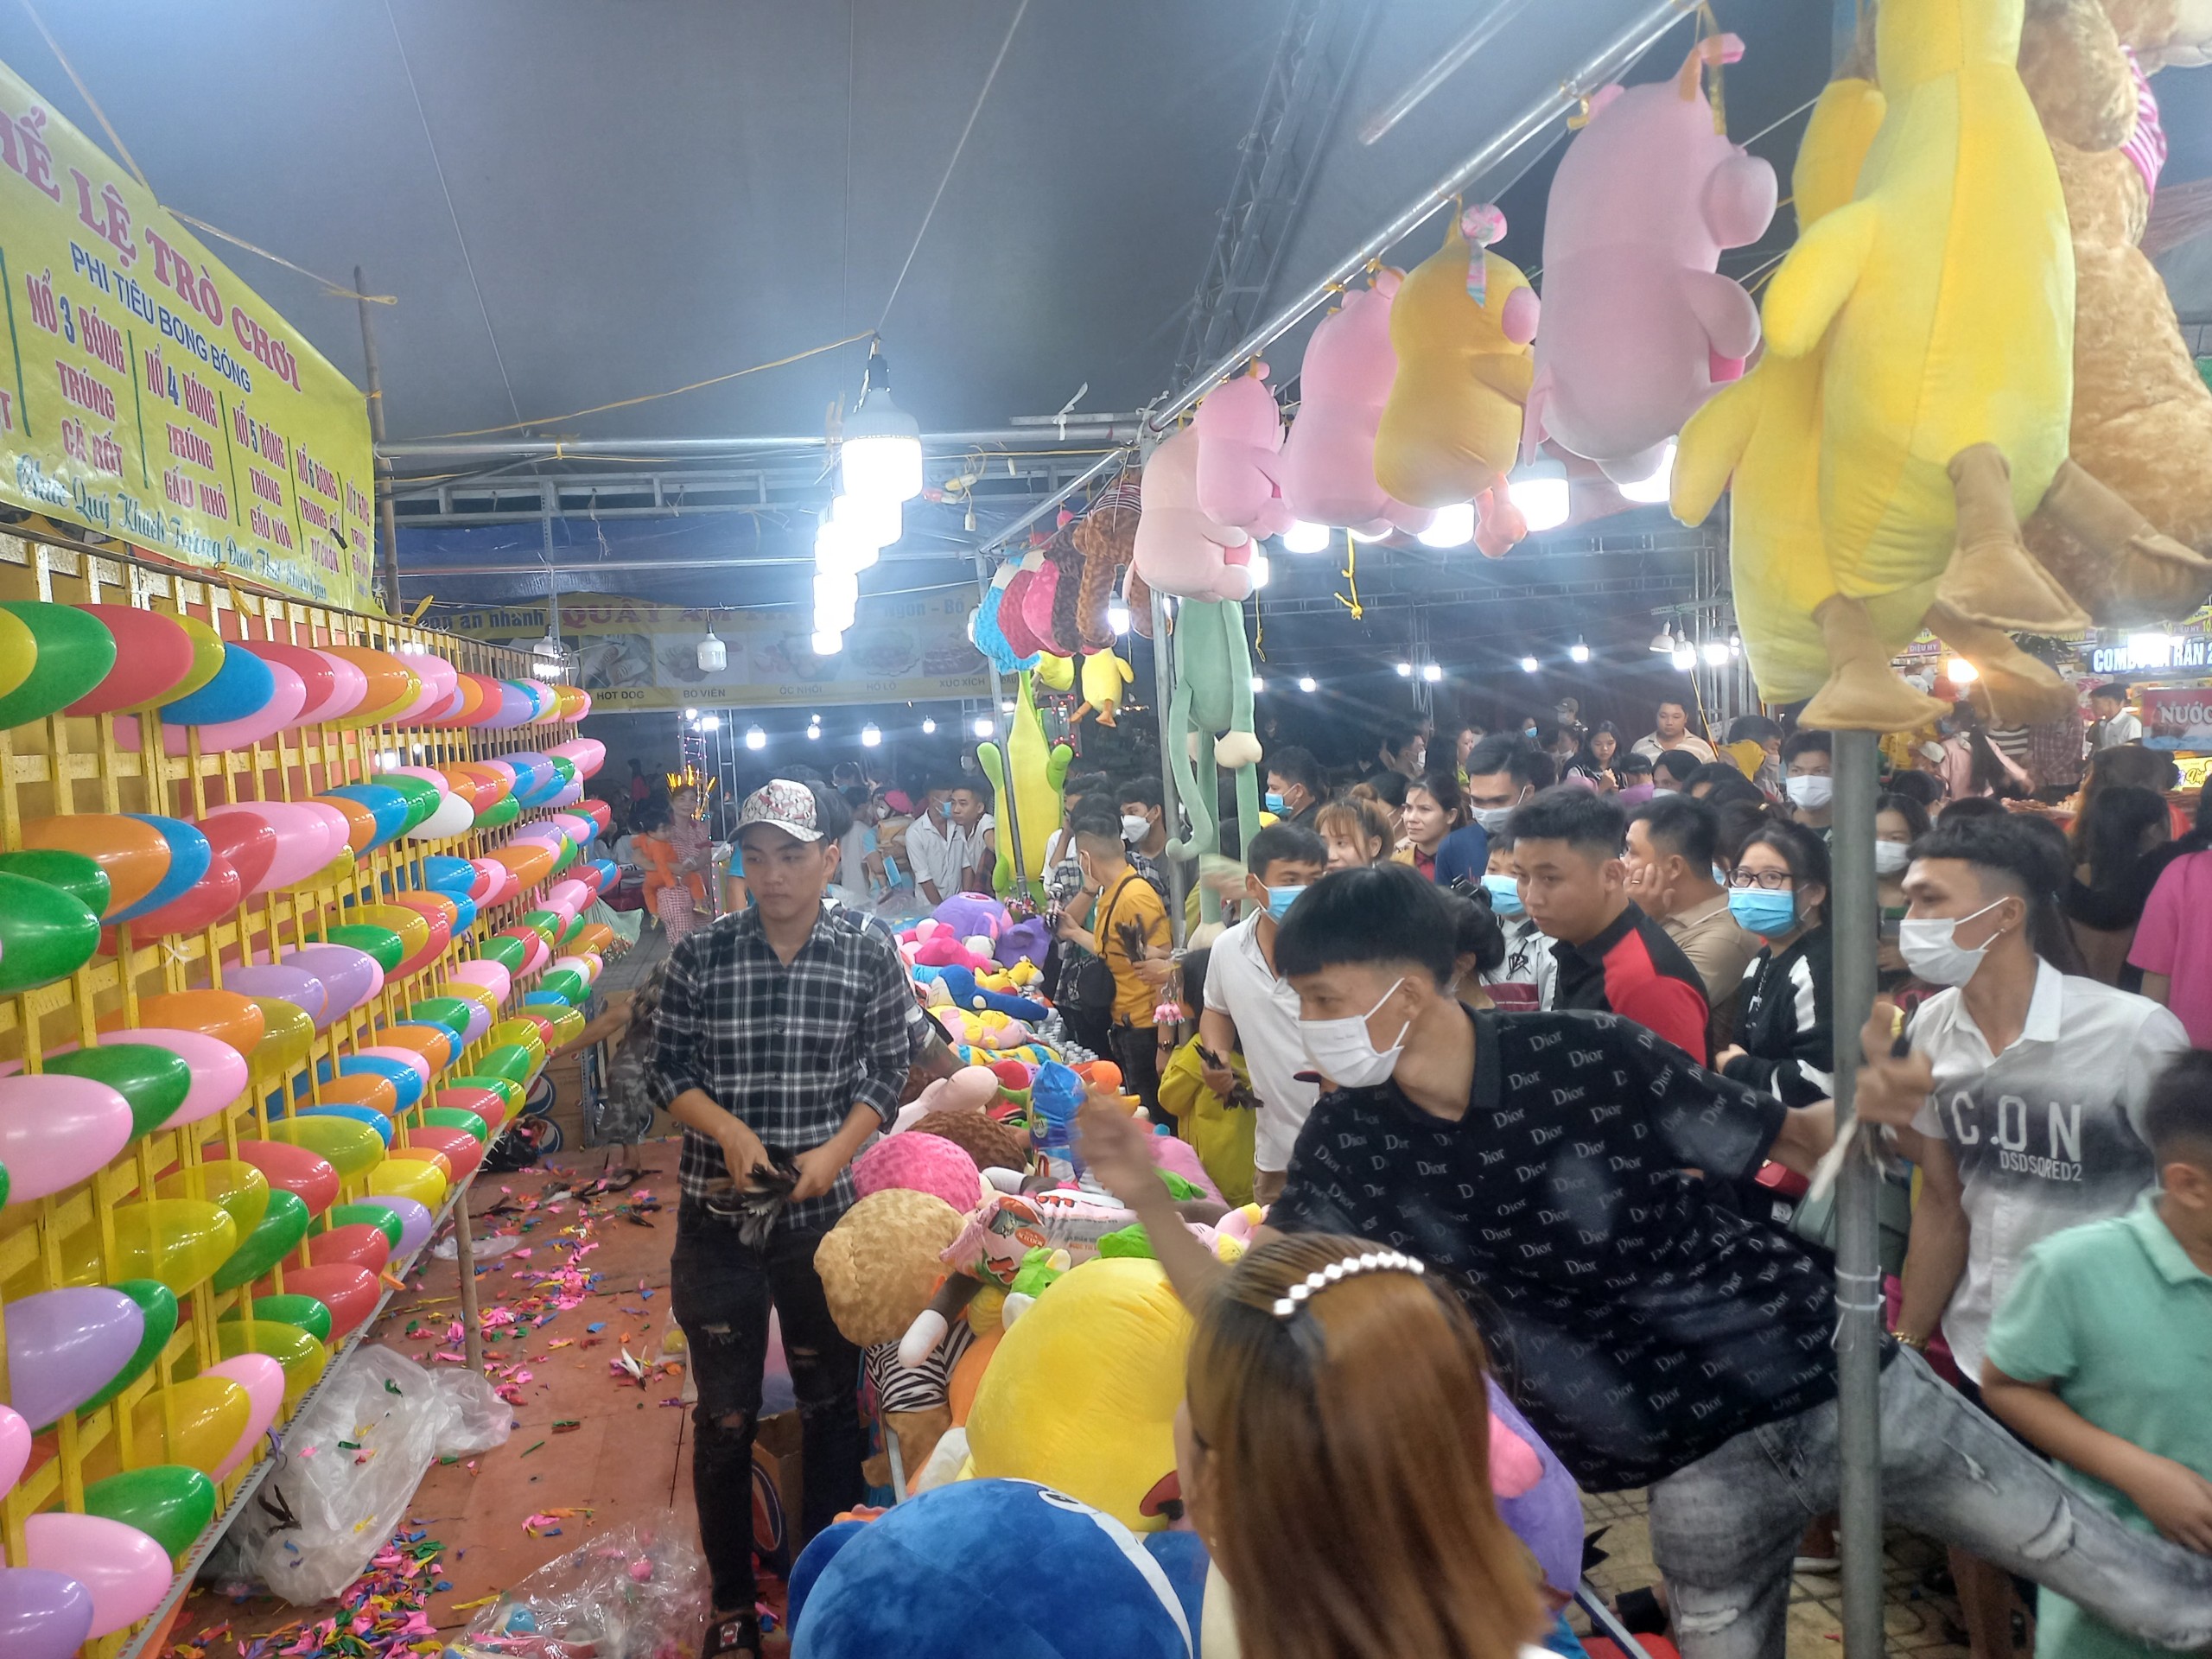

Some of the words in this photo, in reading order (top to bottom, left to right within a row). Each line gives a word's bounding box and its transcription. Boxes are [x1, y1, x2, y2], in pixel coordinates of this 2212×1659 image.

[70, 168, 136, 268] LỆ
[145, 227, 223, 327] TRÒ
[232, 307, 301, 392] CHƠI
[27, 268, 58, 334] NỔ
[60, 296, 75, 344] 3
[79, 306, 126, 374] BÓNG
[70, 241, 110, 293] PHI
[112, 270, 154, 325] TIÊU
[158, 306, 207, 361] BONG
[211, 344, 251, 393] BÓNG
[55, 359, 116, 422] TRÚNG
[145, 343, 164, 399] NỔ
[168, 365, 179, 406] 4
[182, 372, 218, 429] BÓNG
[62, 418, 86, 462] CÀ
[232, 400, 250, 448] NỔ
[249, 418, 257, 454] 5
[259, 423, 286, 470] BÓNG
[166, 423, 214, 471] TRÚNG
[164, 466, 194, 508] GẤU
[199, 483, 227, 520] NHỎ
[249, 467, 282, 507] TRÚNG
[72, 477, 110, 529] Quý
[596, 691, 620, 701] HOT
[621, 690, 645, 700] DOG
[1529, 1031, 1562, 1052] Dior
[1568, 1049, 1604, 1068] Dior
[1508, 1071, 1540, 1090] Dior
[1649, 1065, 1673, 1097] Dior
[1551, 1086, 1585, 1106] Dior
[1493, 1108, 1524, 1128] Dior
[1590, 1105, 1622, 1123] Dior
[1700, 1093, 1727, 1126] Dior
[1530, 1125, 1563, 1146] Dior
[1574, 1140, 1605, 1159] Dior
[1416, 1160, 1447, 1175] Dior
[1516, 1161, 1547, 1183] Dior
[1608, 1155, 1642, 1172] Dior
[1553, 1177, 1586, 1192] Dior
[1538, 1210, 1571, 1225] Dior
[1481, 1227, 1511, 1241] Dior
[1578, 1229, 1609, 1244] Dior
[1679, 1229, 1700, 1255] Dior
[1519, 1242, 1553, 1258] Dior
[1649, 1238, 1674, 1262] Dior
[1564, 1260, 1597, 1274] Dior
[1605, 1272, 1637, 1288] Dior
[1758, 1291, 1789, 1318] Dior
[1804, 1285, 1828, 1312] Dior
[1796, 1325, 1828, 1351] Dior
[1654, 1351, 1686, 1372] Dior
[1700, 1356, 1733, 1379] Dior
[1605, 1382, 1634, 1404] Dior
[1649, 1387, 1681, 1411] Dior
[1690, 1395, 1723, 1420] Dior
